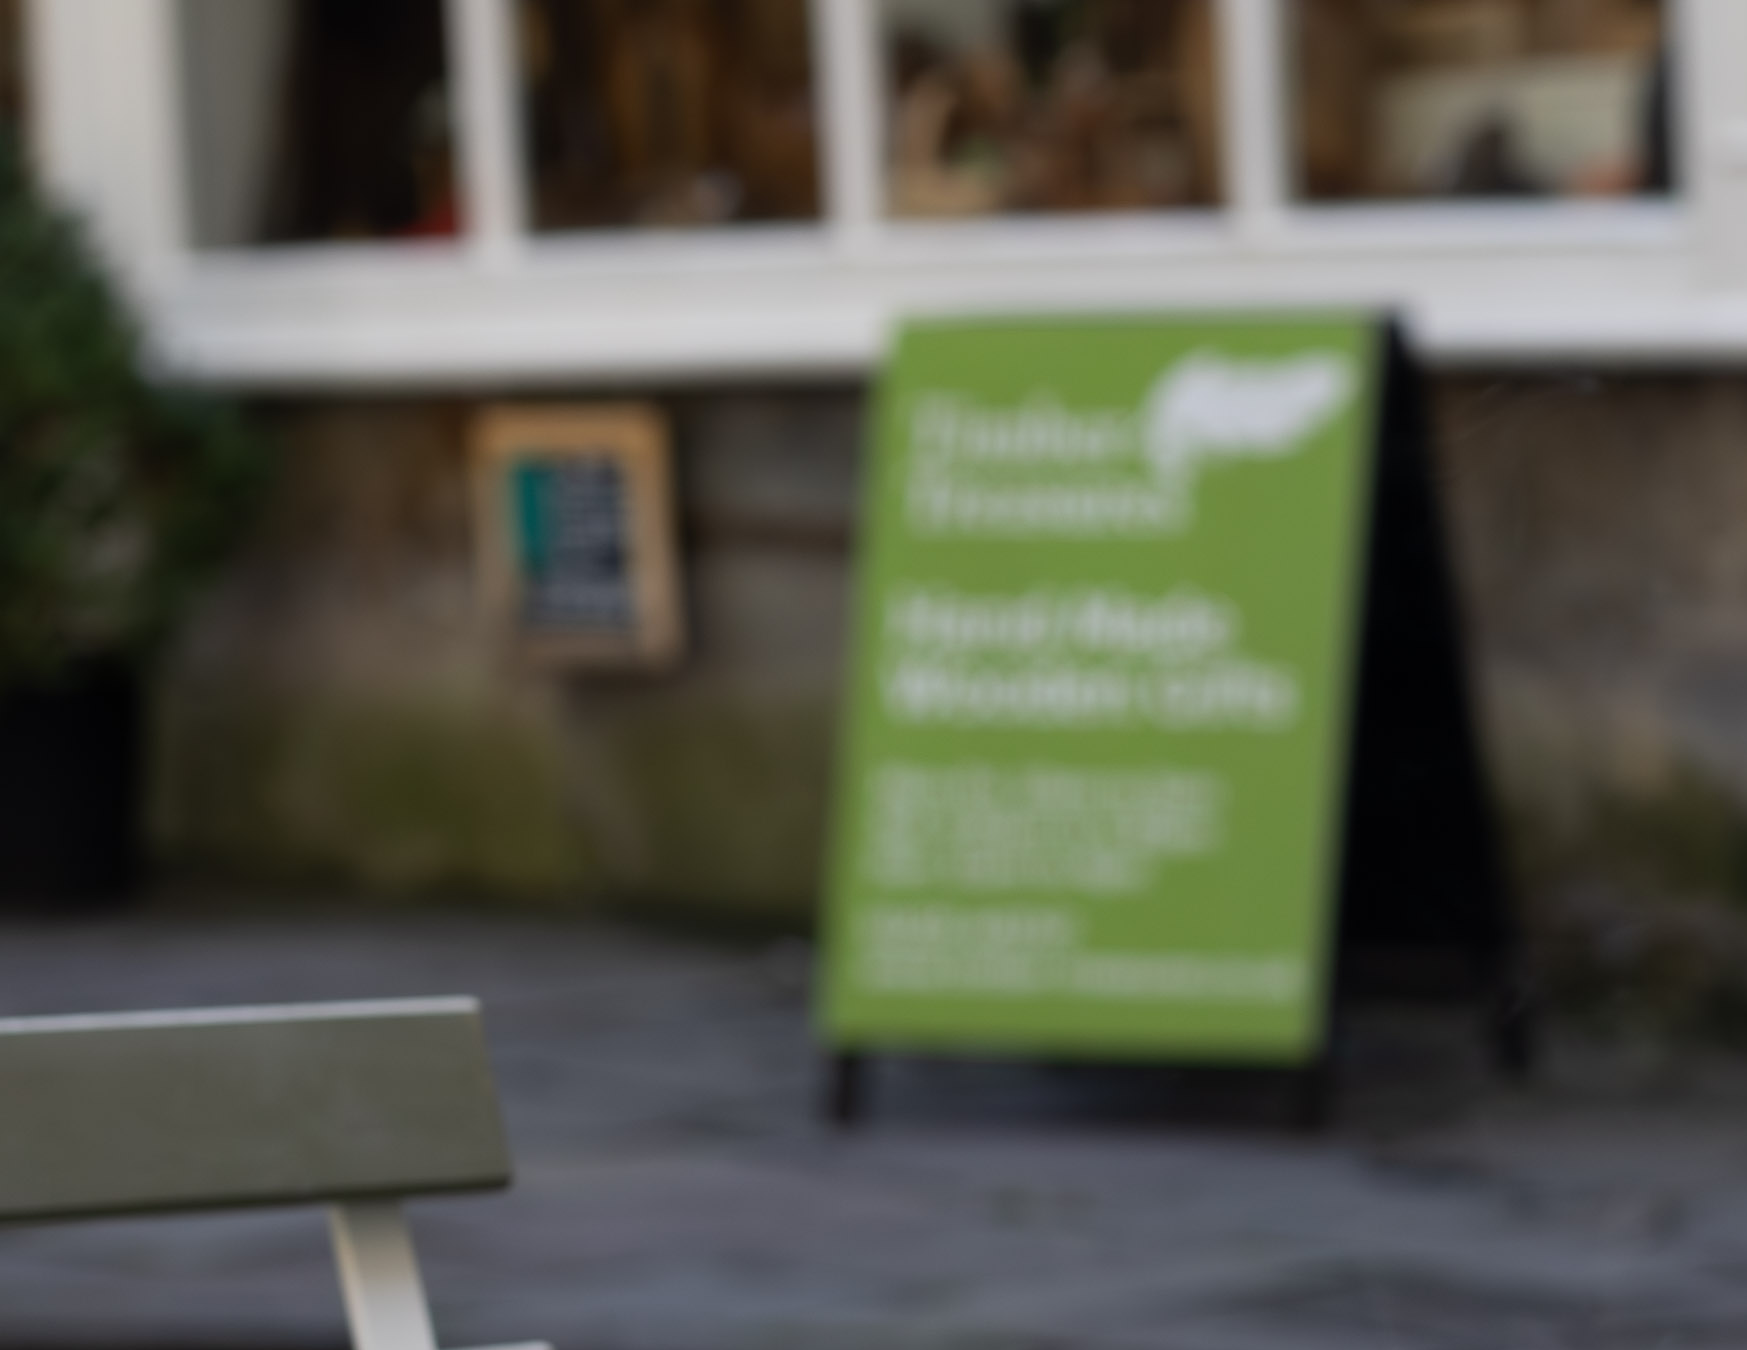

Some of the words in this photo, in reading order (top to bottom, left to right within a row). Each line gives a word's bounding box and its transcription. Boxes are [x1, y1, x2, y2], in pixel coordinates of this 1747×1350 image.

[884, 584, 1056, 654] Hand
[1072, 586, 1240, 660] Made
[880, 652, 1134, 730] Wooden
